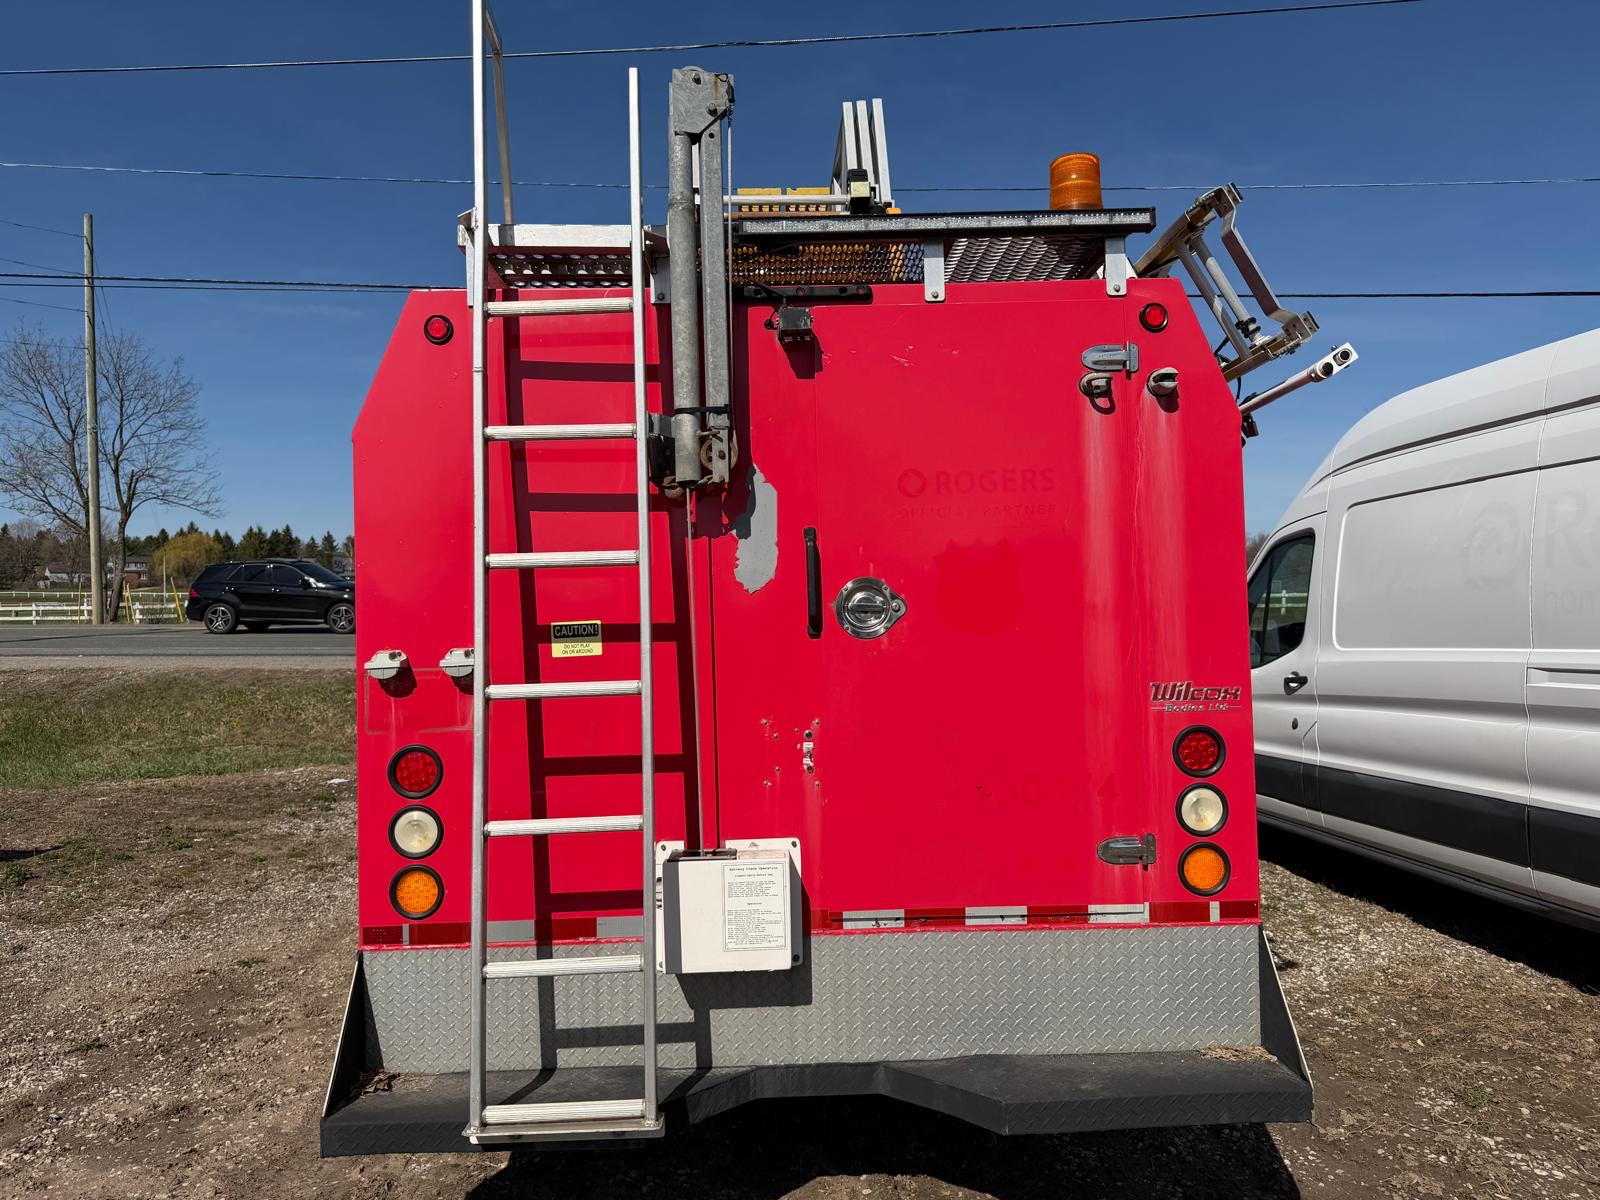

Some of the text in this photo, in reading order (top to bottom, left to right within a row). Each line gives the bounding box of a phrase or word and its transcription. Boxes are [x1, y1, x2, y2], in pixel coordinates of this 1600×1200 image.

[935, 467, 1055, 495] ROGERS
[897, 503, 1057, 520] OFFICIA PARTNER
[1543, 490, 1600, 569] R
[554, 624, 598, 636] CAUTION!
[1150, 680, 1242, 702] Wilcox
[1165, 703, 1204, 713] Bodies
